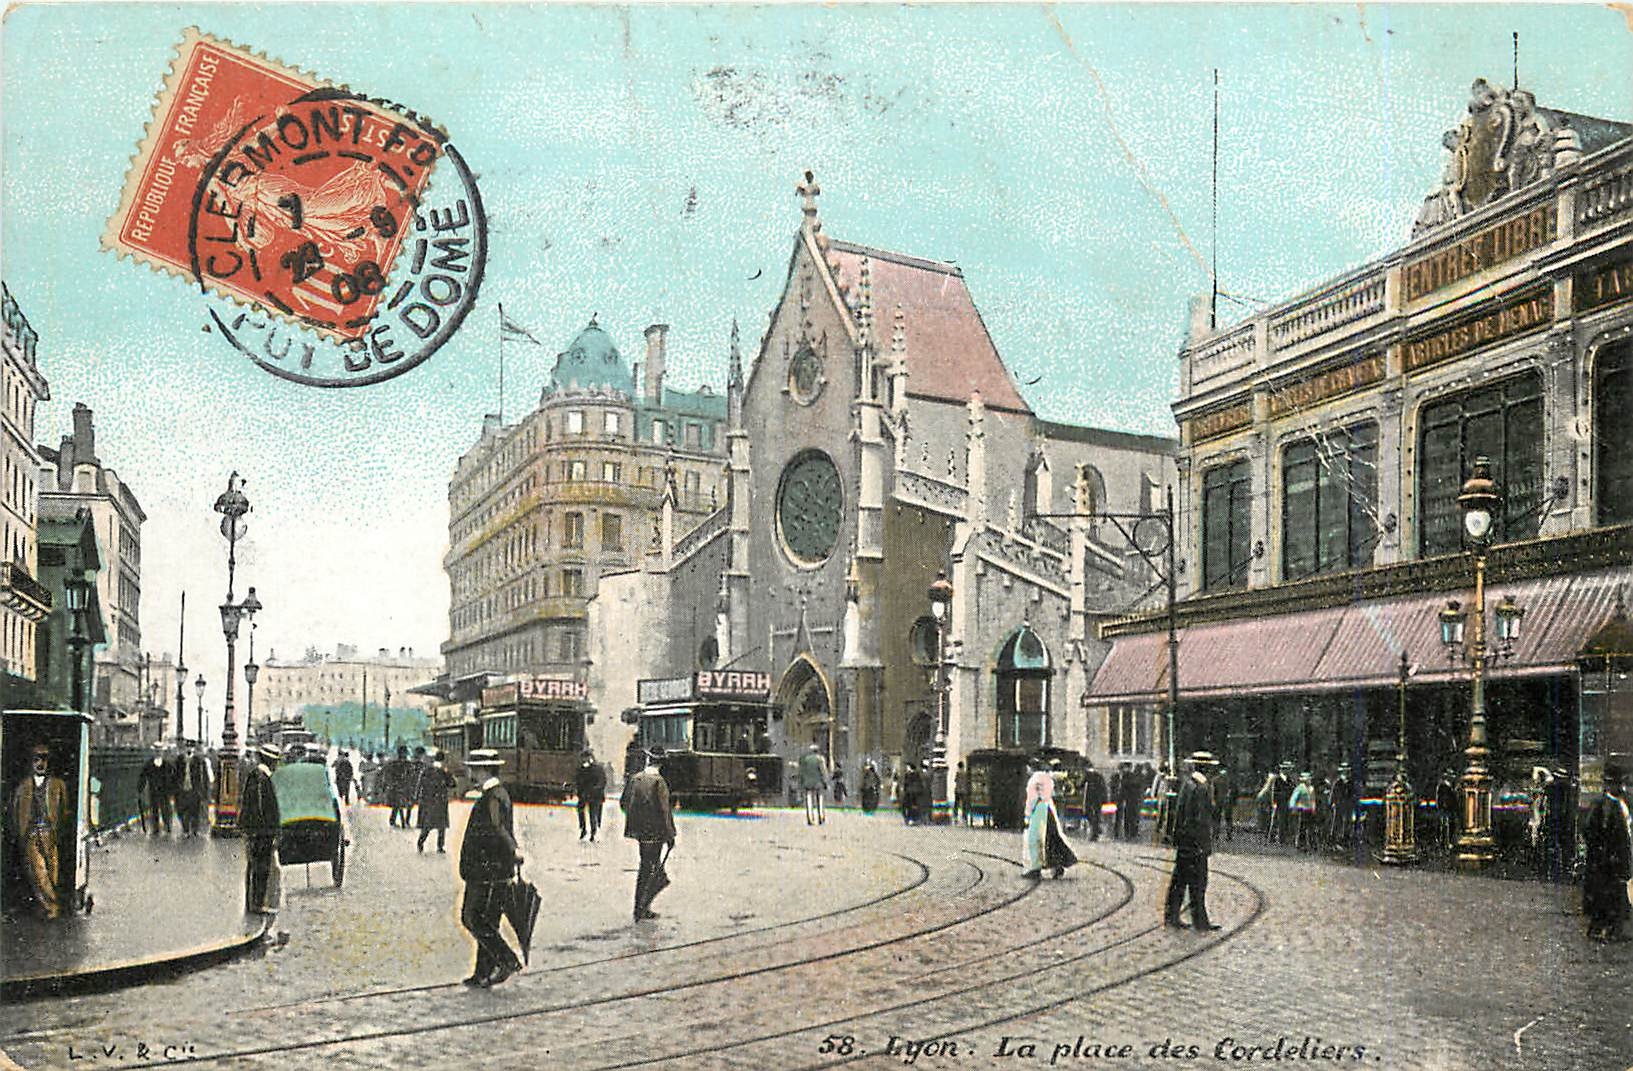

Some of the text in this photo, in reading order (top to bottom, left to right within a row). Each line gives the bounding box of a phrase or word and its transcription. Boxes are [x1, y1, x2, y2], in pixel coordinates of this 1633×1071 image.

[175, 53, 220, 136] FRANÇAISE
[205, 105, 374, 279] CLERMONT
[520, 680, 588, 697] BYRRH
[697, 670, 771, 690] BYRRH
